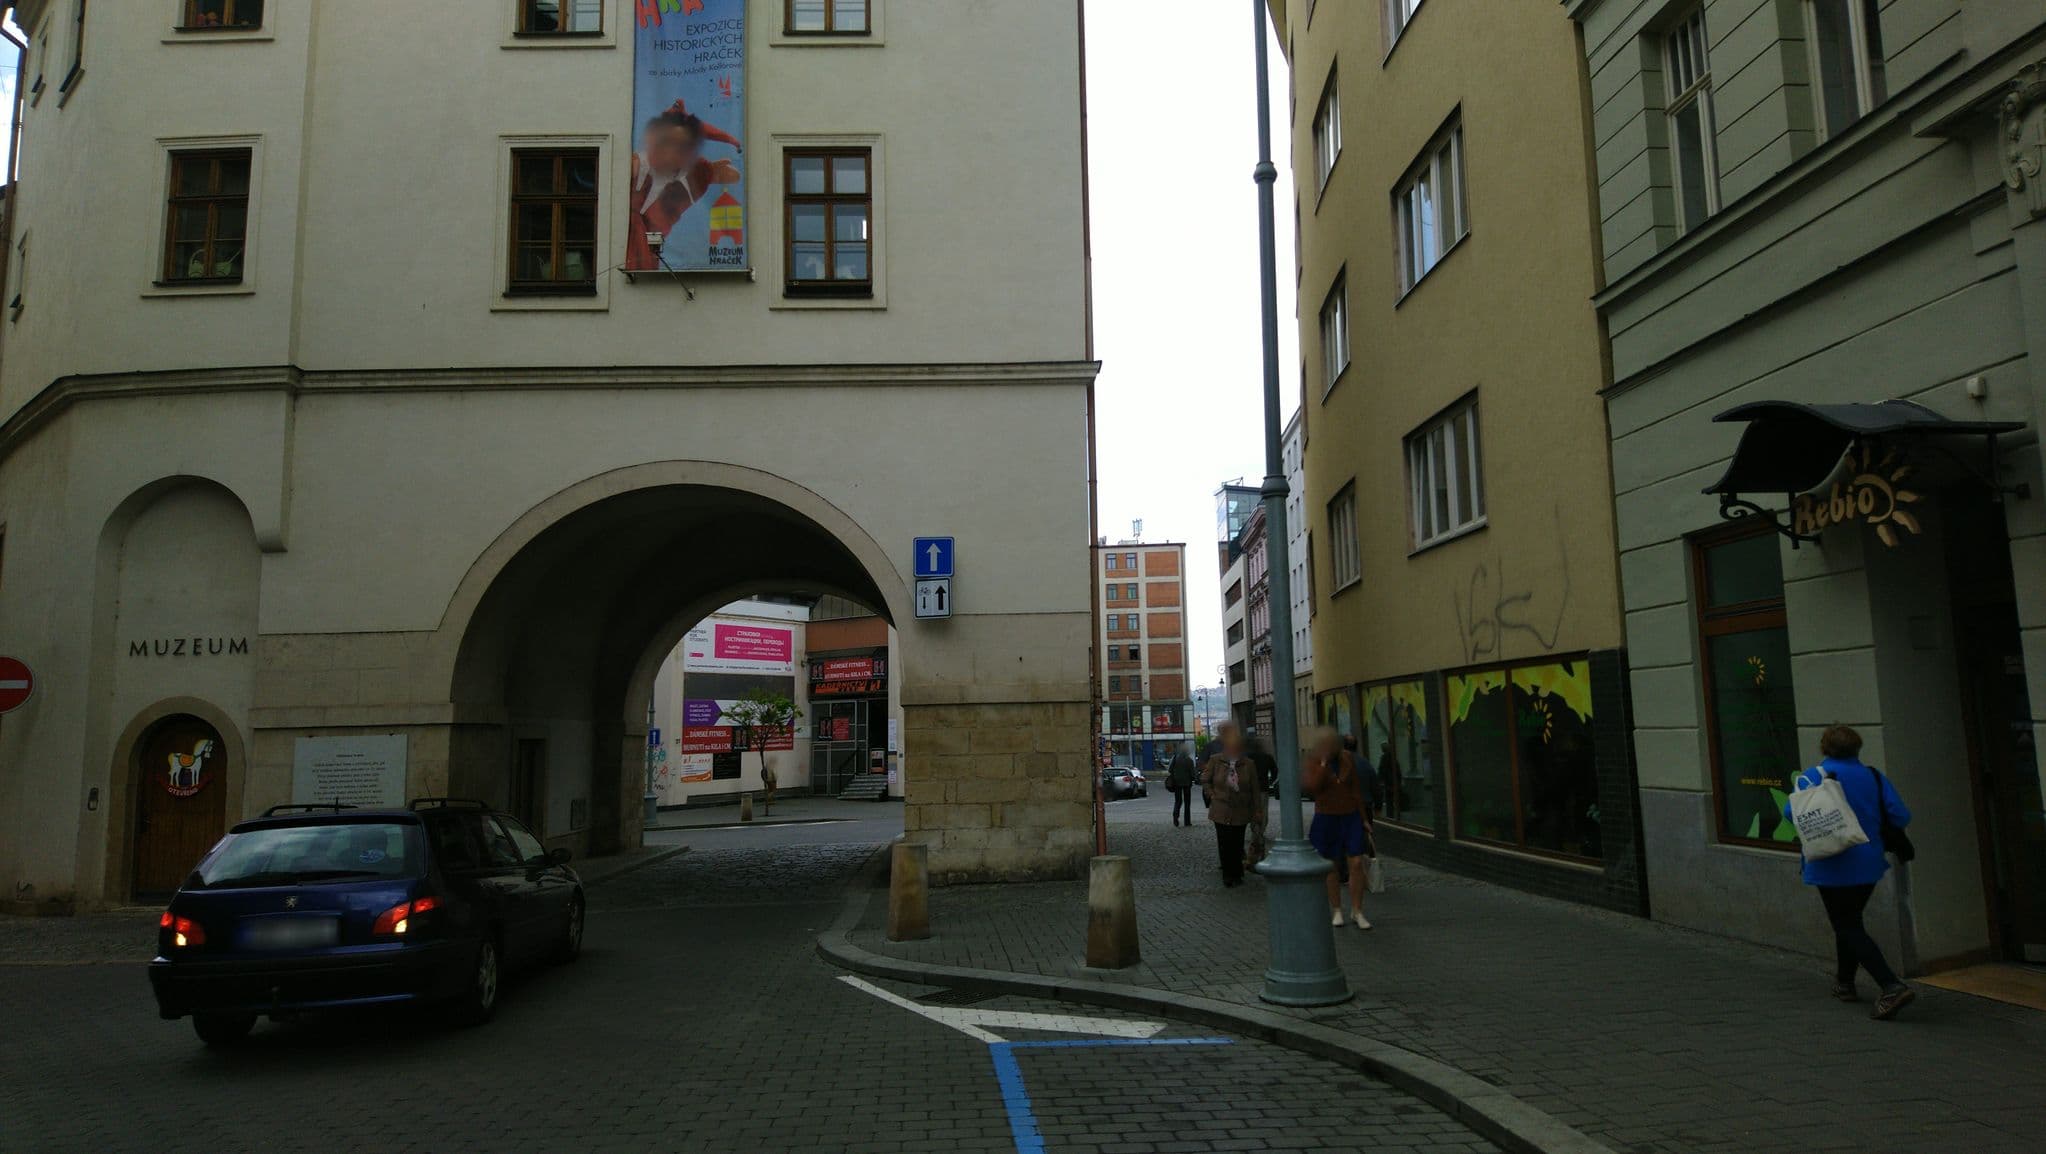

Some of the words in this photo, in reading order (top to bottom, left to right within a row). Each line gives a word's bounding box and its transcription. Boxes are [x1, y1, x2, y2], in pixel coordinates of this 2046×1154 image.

[686, 18, 744, 36] EXPOZICE
[654, 32, 743, 51] HISTORICKÝCH
[694, 46, 743, 63] HRAČEK
[709, 246, 743, 256] MUZEUM
[709, 256, 742, 265] HRAČEK
[1794, 481, 1875, 536] Rebio
[129, 636, 248, 657] MUZEUM
